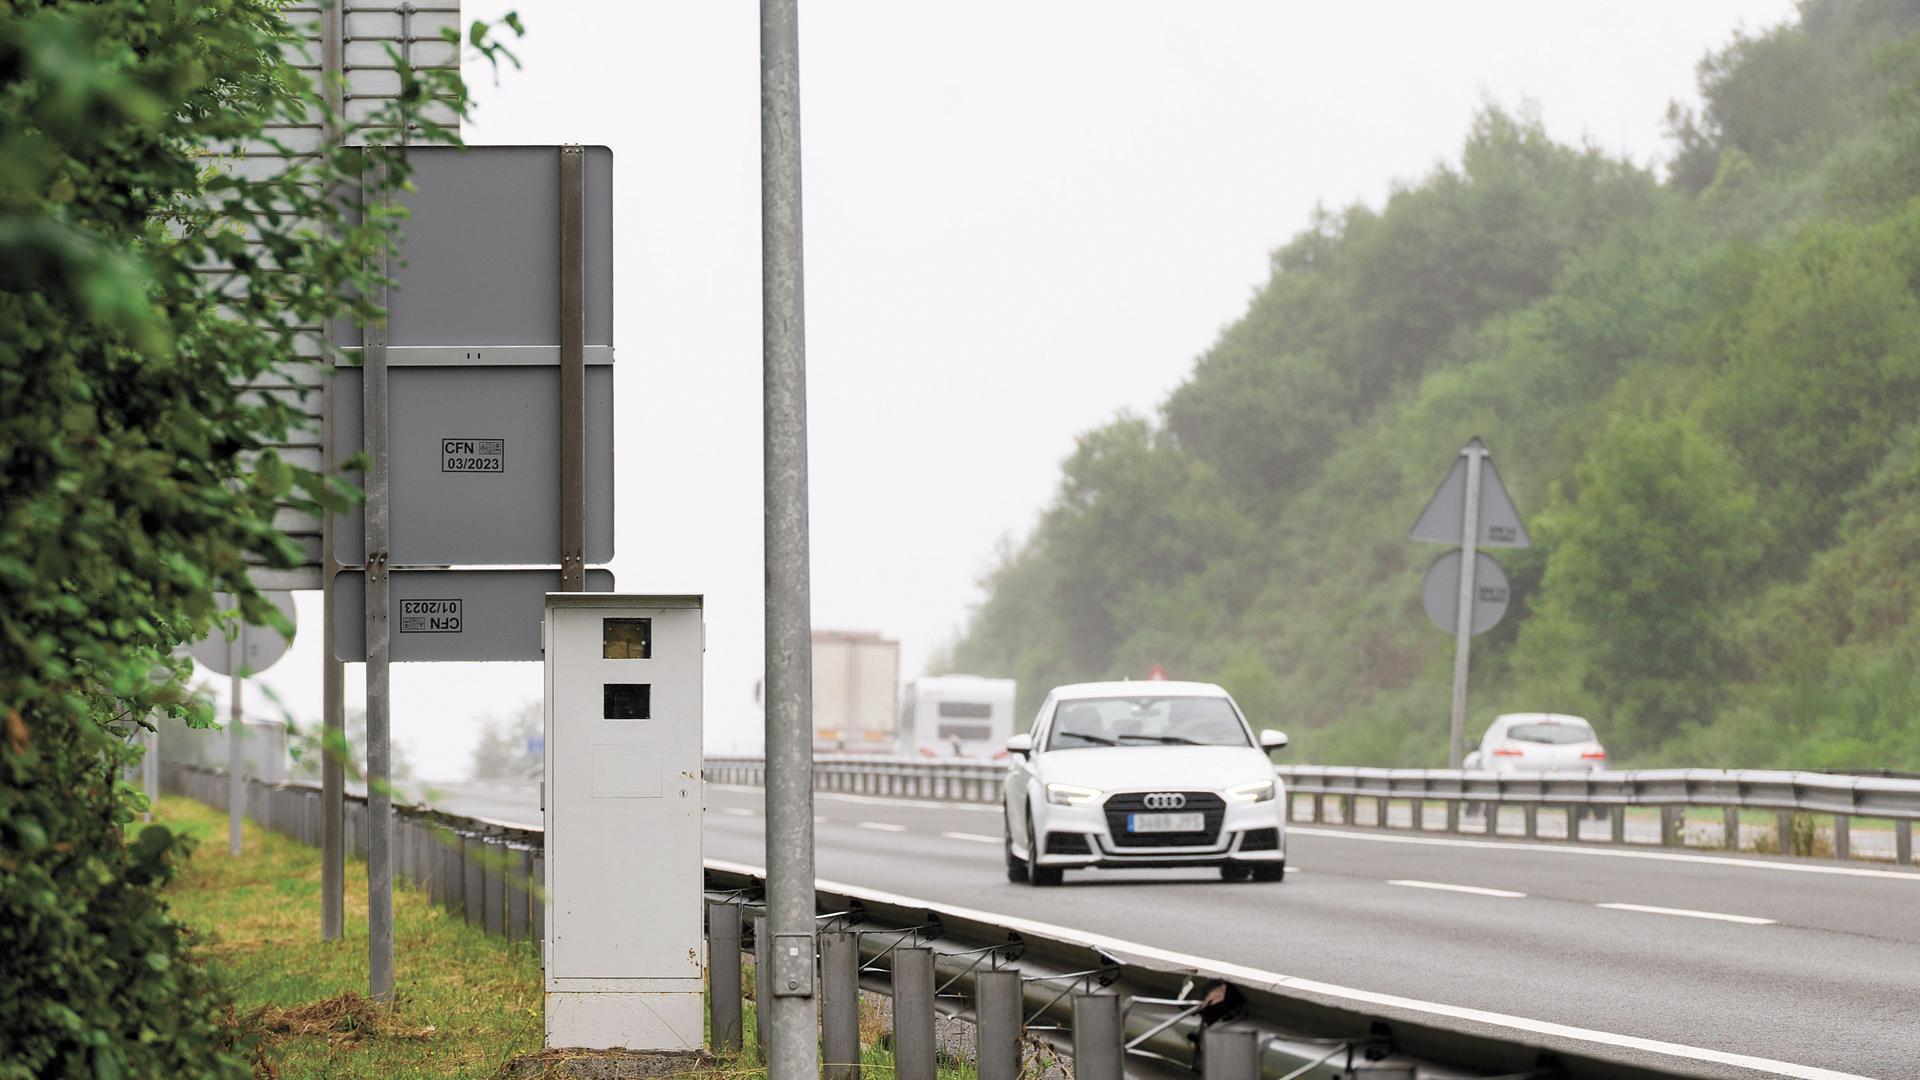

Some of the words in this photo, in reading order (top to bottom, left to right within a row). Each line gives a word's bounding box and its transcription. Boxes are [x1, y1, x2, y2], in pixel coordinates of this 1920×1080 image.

[445, 442, 474, 454] CFN
[448, 458, 499, 470] 03/2023
[405, 602, 457, 614] 01/2023
[430, 617, 459, 629] CFN
